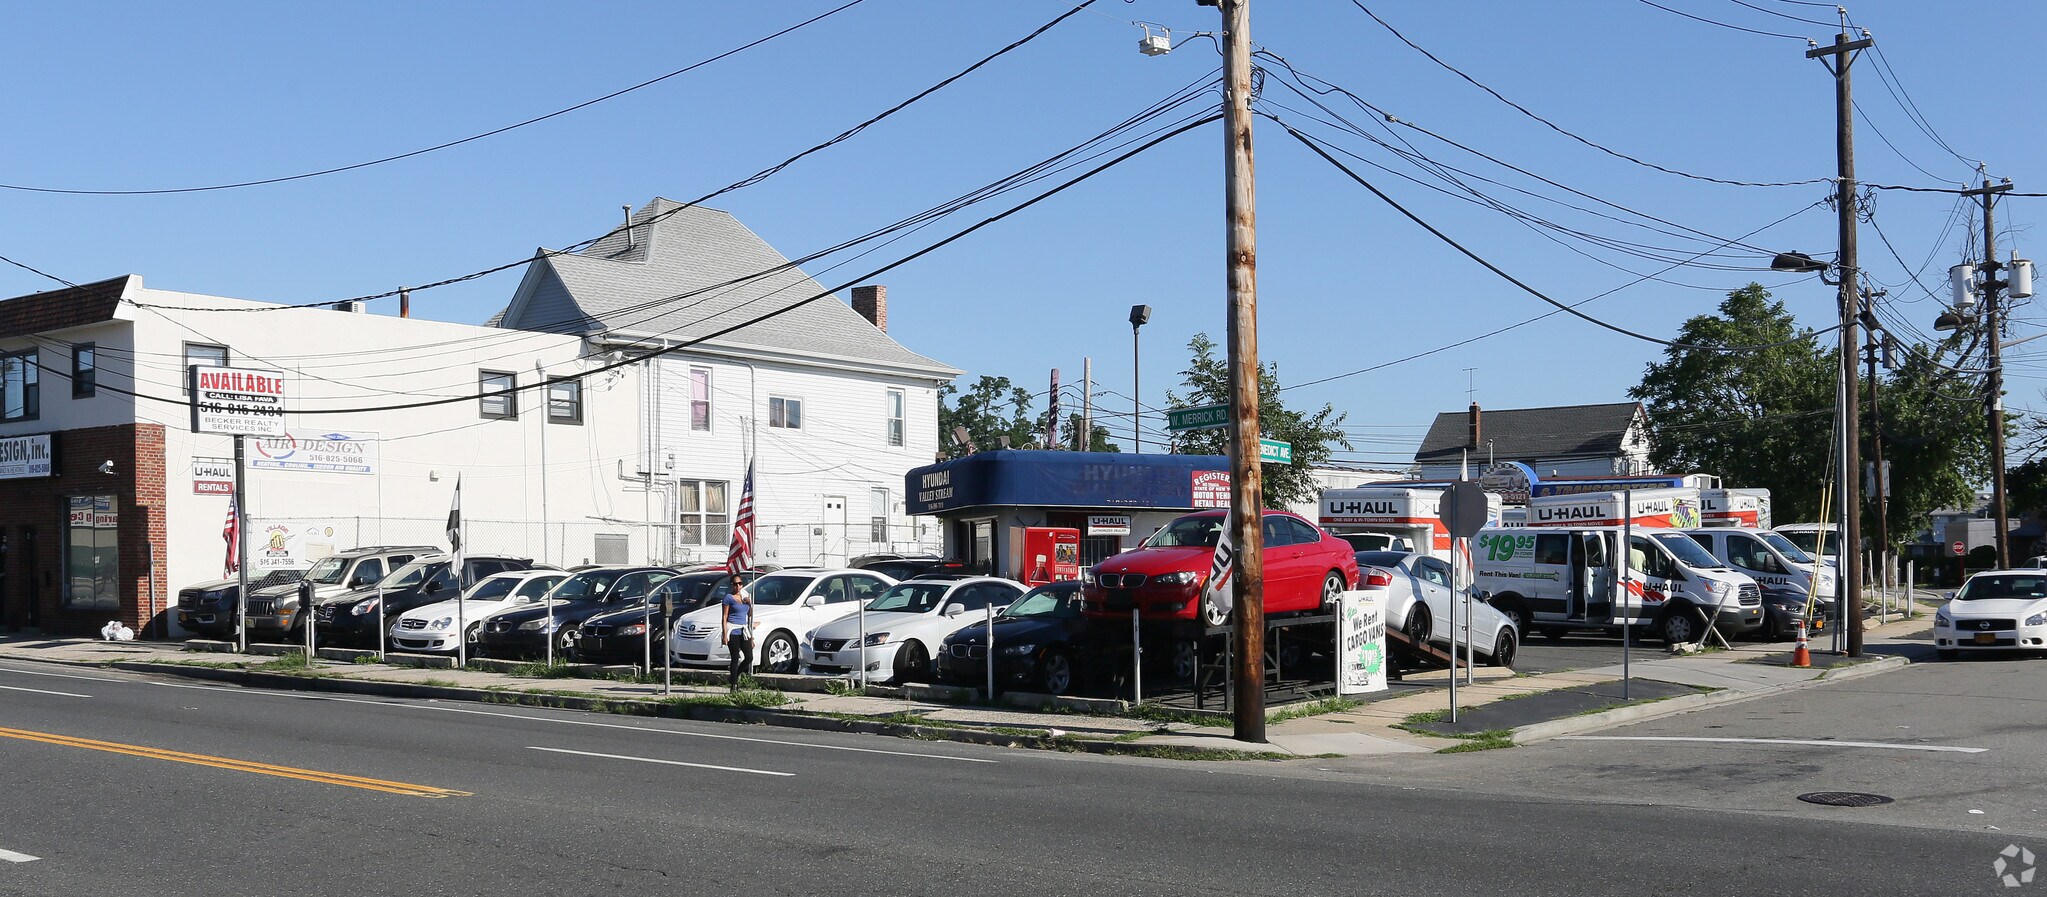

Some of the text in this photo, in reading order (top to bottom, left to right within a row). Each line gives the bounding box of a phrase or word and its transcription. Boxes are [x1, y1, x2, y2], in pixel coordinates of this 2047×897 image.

[200, 372, 282, 394] AVAILABLE
[1170, 409, 1228, 426] W. MERRICK RD.
[262, 438, 366, 454] AIR DESIGN
[309, 454, 363, 464] 516-825-5066
[194, 466, 231, 478] U-HAUL
[922, 470, 950, 488] HYUNDAI
[1194, 472, 1230, 486] REGISTER
[198, 484, 229, 492] RENTALS
[1330, 502, 1398, 514] U-HAUL
[1538, 506, 1606, 520] U-HAUL
[1638, 501, 1668, 514] U-HAUL
[1643, 582, 1684, 593] U-HAUL
[1352, 610, 1378, 632] We Rent
[1347, 622, 1384, 652] CARGO VANS
